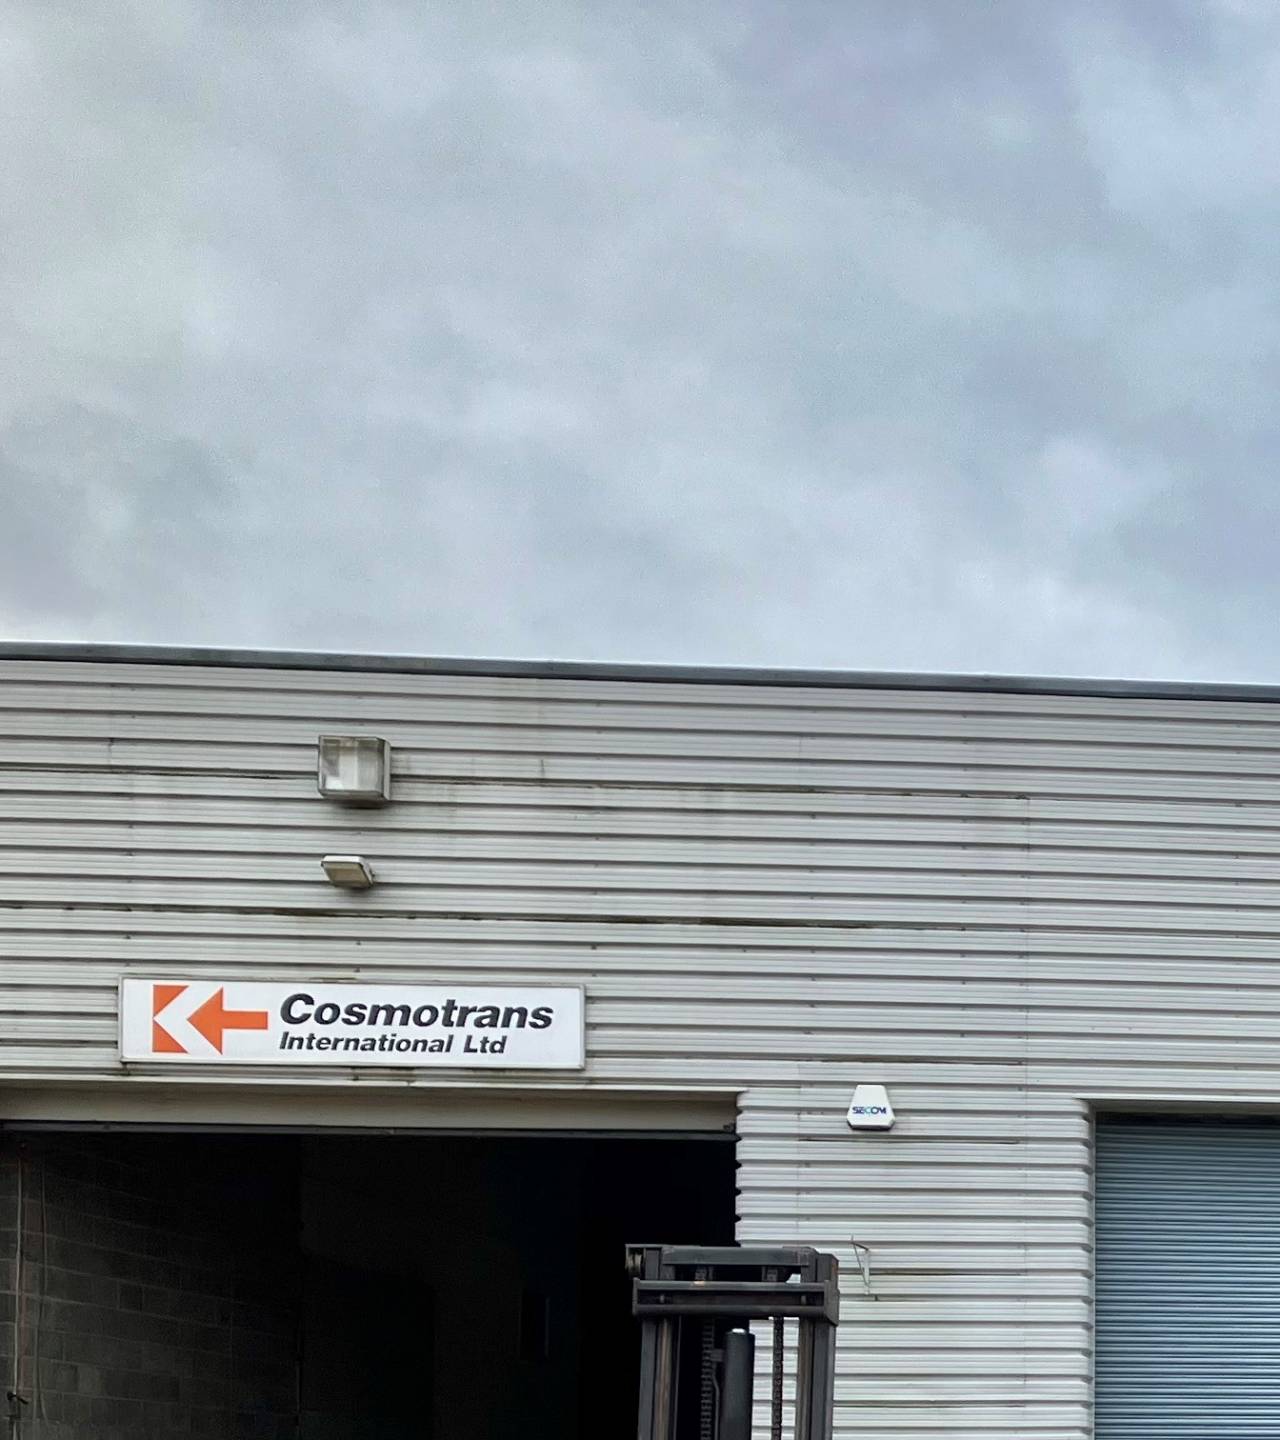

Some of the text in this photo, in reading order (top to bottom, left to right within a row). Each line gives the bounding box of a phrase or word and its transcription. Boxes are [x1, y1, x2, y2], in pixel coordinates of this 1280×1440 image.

[280, 993, 554, 1029] Cosmotrans
[279, 1031, 508, 1054] International Ltd
[852, 1106, 887, 1115] SECOM
